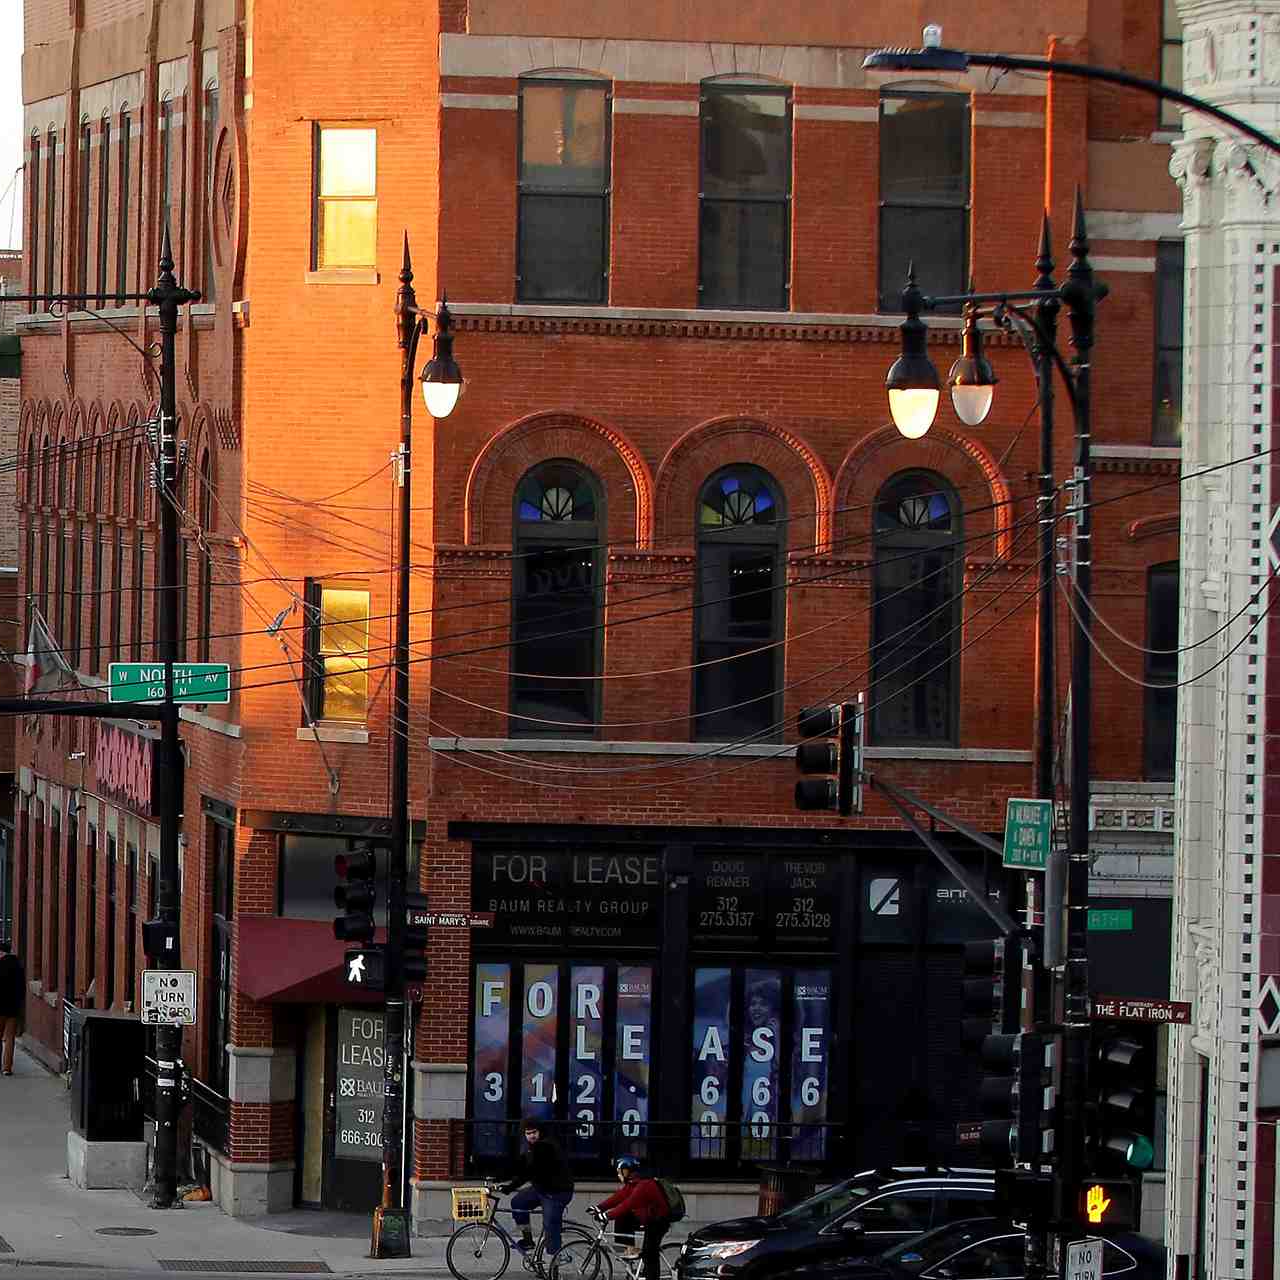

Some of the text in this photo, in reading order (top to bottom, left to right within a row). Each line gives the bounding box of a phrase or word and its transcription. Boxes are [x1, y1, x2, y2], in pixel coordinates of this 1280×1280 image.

[118, 671, 128, 681] W
[204, 673, 219, 683] AV
[147, 687, 166, 698] 160
[491, 854, 660, 885] FOR LEASE
[790, 877, 817, 889] JACK
[489, 899, 531, 912] BAUM
[599, 900, 649, 914] GROUP
[717, 896, 739, 912] 312
[792, 897, 815, 913] 312
[414, 915, 436, 925] SAINT
[438, 916, 467, 926] MARY'S
[775, 912, 832, 928] 275.3128
[159, 977, 179, 988] NO
[154, 990, 185, 1003] TURN
[482, 981, 601, 1020] FOR
[1095, 1004, 1116, 1016] THE
[1119, 1005, 1145, 1017] FLAT
[1148, 1007, 1173, 1020] IRON
[576, 1025, 824, 1063] LEASE
[356, 1079, 385, 1096] BAU
[358, 1108, 376, 1124] 312
[1078, 1250, 1092, 1265] NO
